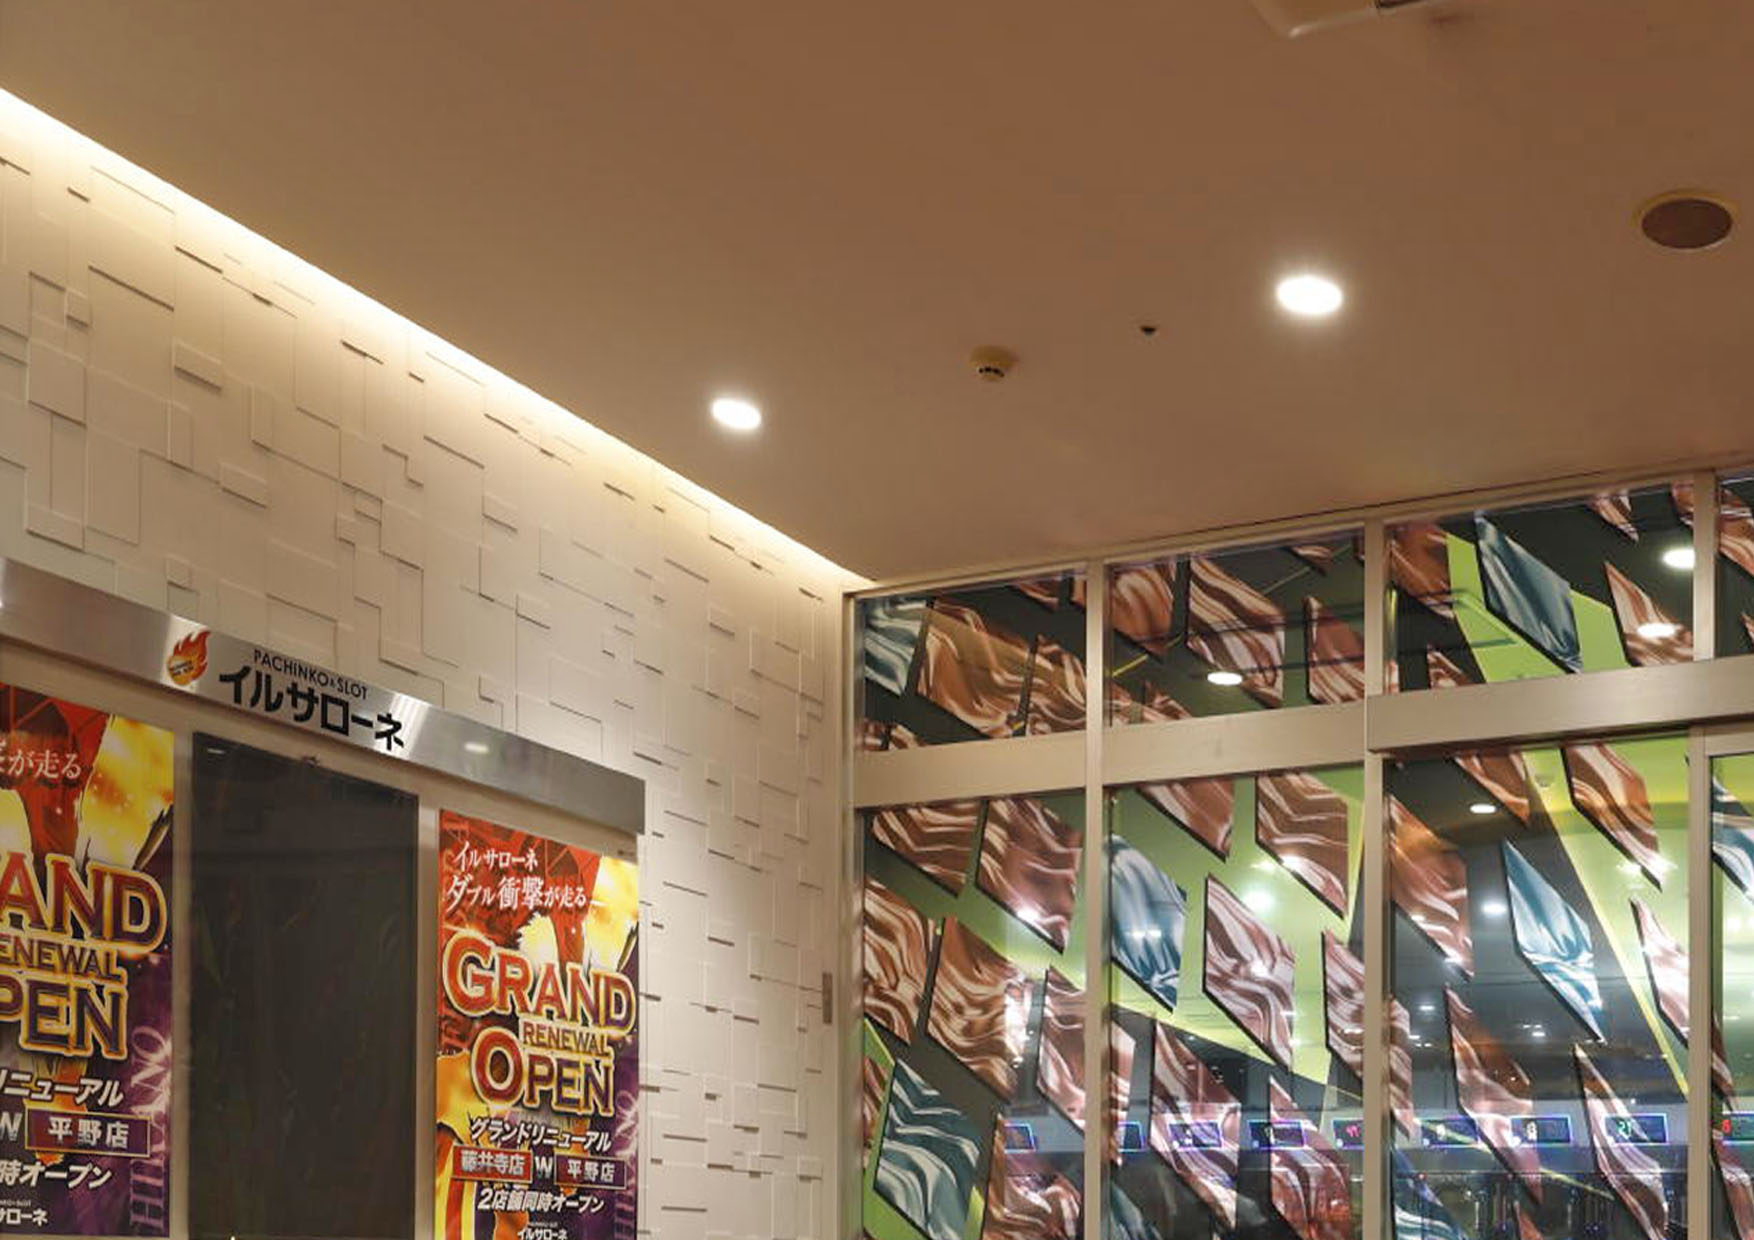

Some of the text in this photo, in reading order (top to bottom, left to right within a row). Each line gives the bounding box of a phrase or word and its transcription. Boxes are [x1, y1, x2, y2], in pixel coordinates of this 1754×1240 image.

[219, 666, 404, 751] イルサローネ
[0, 738, 81, 779] が走る
[453, 841, 539, 872] イルサローネ
[446, 873, 588, 914] ダブル衝撃が走る
[443, 929, 637, 1034] GRAND
[521, 1020, 614, 1058] RENEWAL
[471, 1026, 616, 1118] OPEN
[48, 1116, 129, 1150] 平野店
[470, 1117, 613, 1152] グランドリニューアル
[460, 1150, 616, 1184] 藤井寺店 W 平野店
[477, 1187, 605, 1214] 2店舗同時オープン
